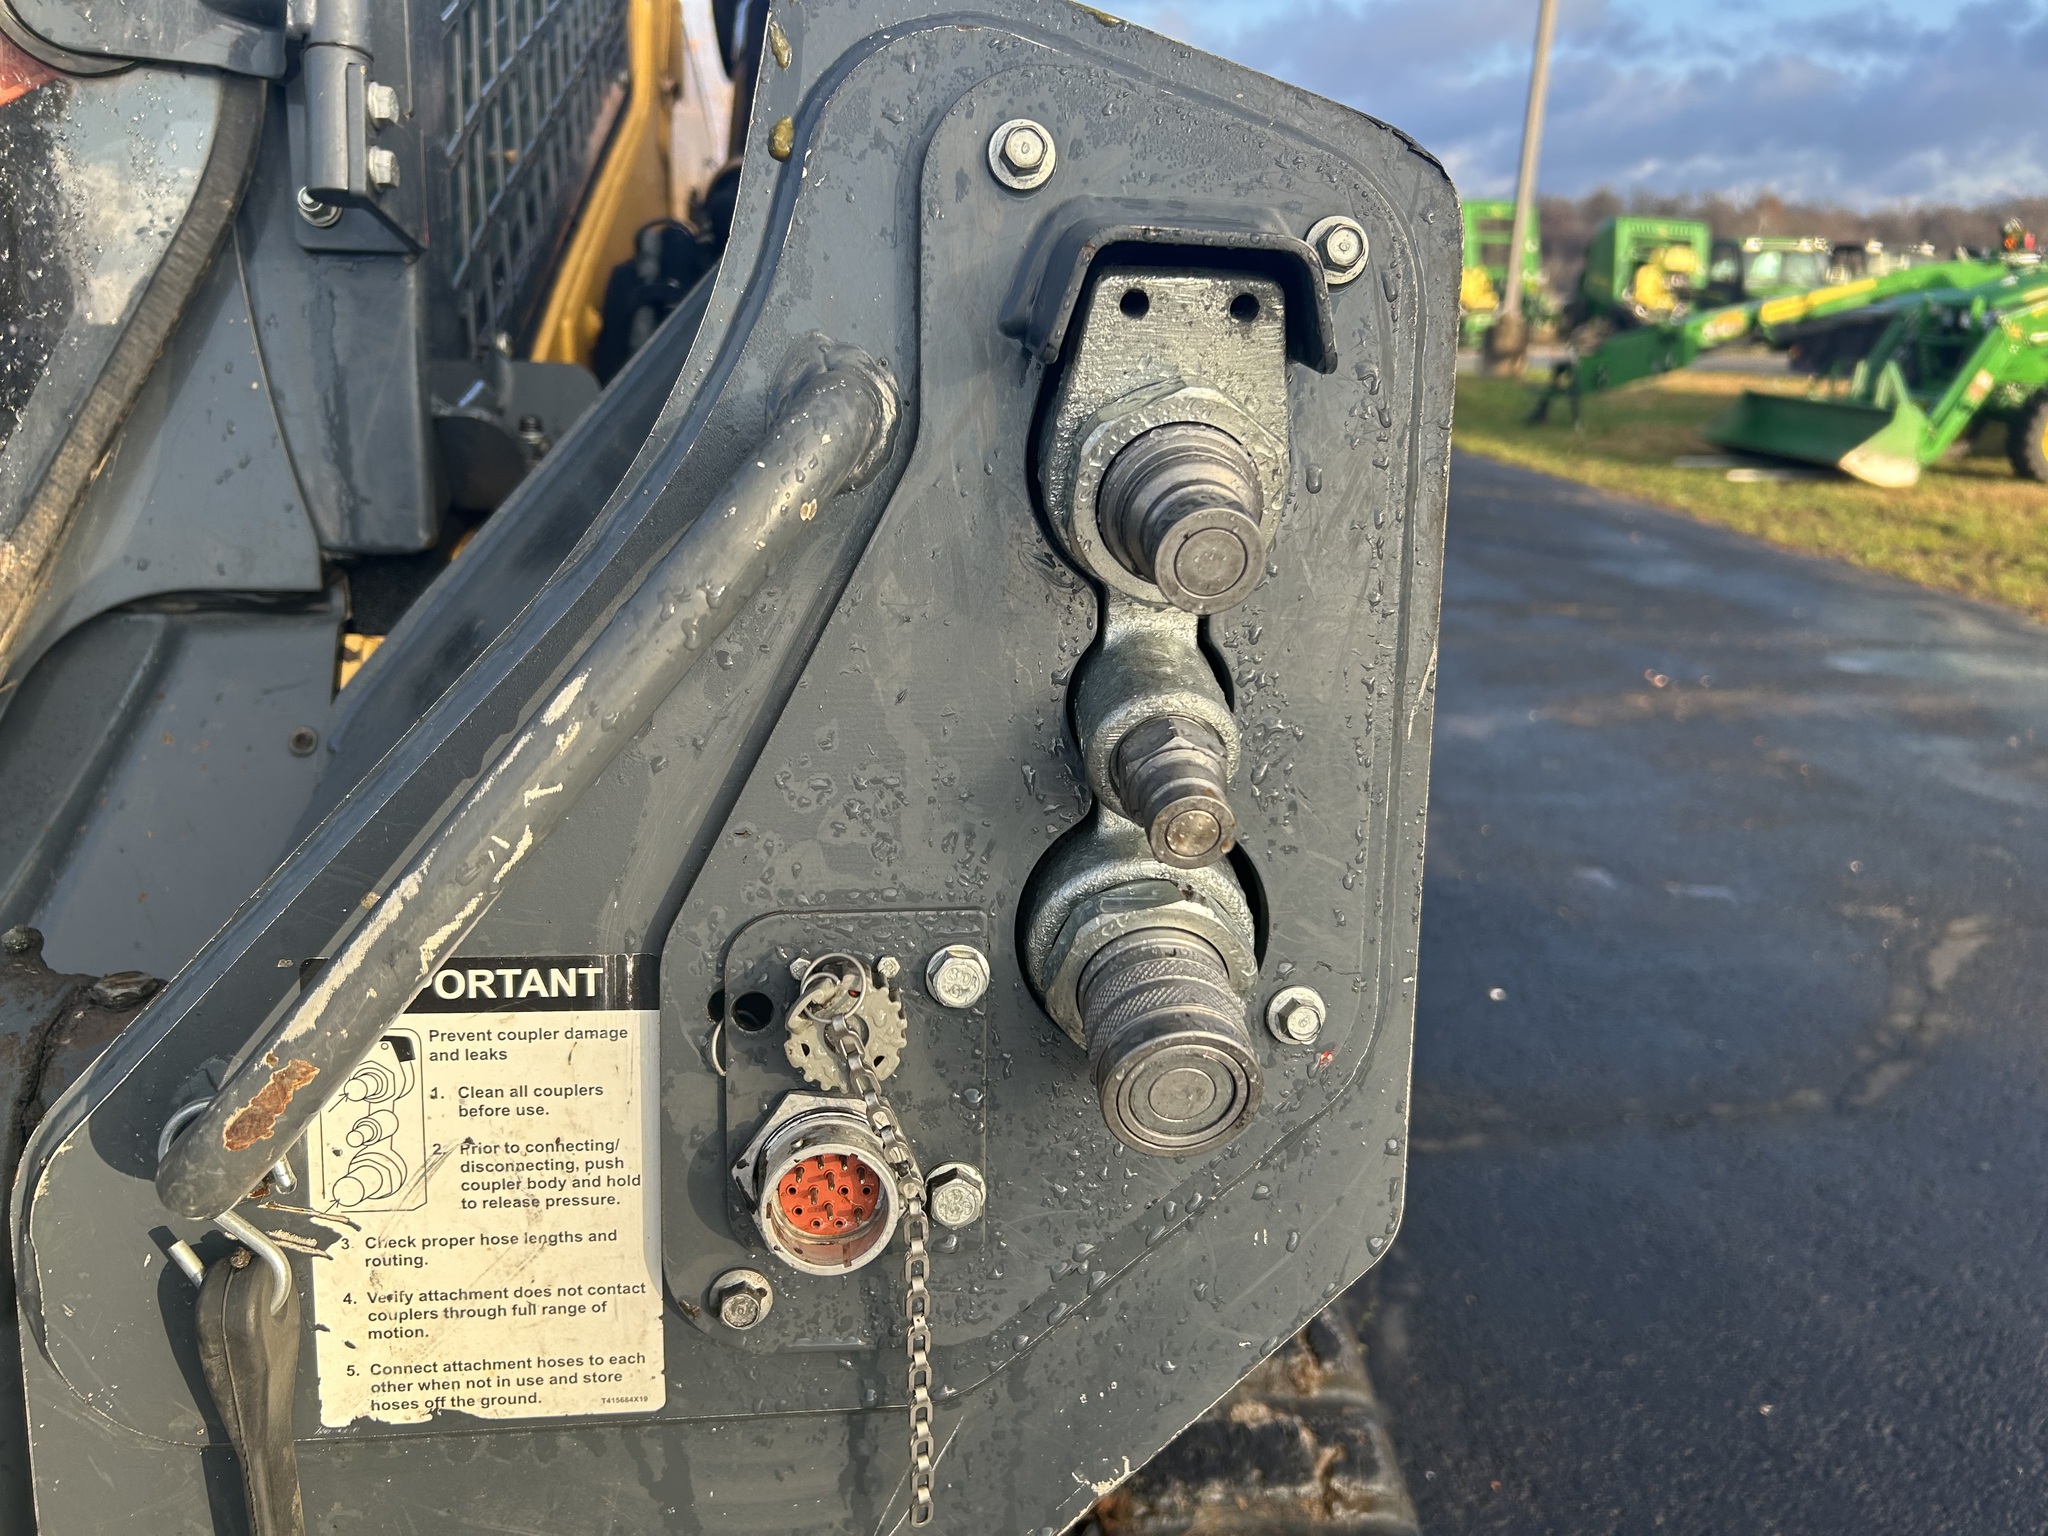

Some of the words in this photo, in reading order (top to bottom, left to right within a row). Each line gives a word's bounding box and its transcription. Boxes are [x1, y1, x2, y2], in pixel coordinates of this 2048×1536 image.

[424, 967, 604, 1000] ORTANT
[429, 1029, 493, 1042] Prevent
[497, 1027, 560, 1044] coupler
[564, 1026, 628, 1042] damage
[429, 1048, 460, 1062] and
[465, 1047, 508, 1061] leaks
[429, 1086, 445, 1100] 1.
[457, 1086, 504, 1099] Clean
[509, 1084, 528, 1098] all
[533, 1083, 604, 1100] couplers
[458, 1104, 511, 1118] before
[516, 1105, 550, 1116] use.
[459, 1142, 501, 1156] Prior
[503, 1141, 520, 1155] to
[524, 1138, 621, 1154] connecting/
[460, 1158, 580, 1174] disconnecting,
[585, 1156, 624, 1173] push
[460, 1176, 522, 1194] coupler
[527, 1176, 567, 1192] body
[571, 1175, 601, 1189] and
[606, 1173, 641, 1188] hold
[460, 1197, 477, 1210] to
[482, 1193, 541, 1209] release
[545, 1195, 620, 1210] pressure.
[365, 1235, 417, 1250] Check
[421, 1236, 476, 1251] proper
[480, 1233, 519, 1246] hose
[524, 1231, 583, 1248] lengths
[588, 1229, 617, 1242] and
[365, 1253, 429, 1269] routing.
[342, 1292, 357, 1305] 4.
[418, 1287, 509, 1302] attachment
[513, 1286, 552, 1299] does
[557, 1284, 583, 1297] not
[587, 1282, 646, 1296] contact
[367, 1307, 439, 1324] couplers
[442, 1304, 507, 1321] through
[511, 1301, 537, 1316] full
[542, 1304, 587, 1317] range
[591, 1300, 608, 1313] of
[368, 1326, 429, 1340] motion.
[346, 1364, 360, 1377] 5.
[370, 1361, 439, 1376] Connect
[442, 1357, 533, 1373] attachment
[537, 1356, 584, 1369] hoses
[588, 1354, 605, 1366] to
[608, 1352, 646, 1365] each
[370, 1380, 414, 1394] other
[417, 1378, 461, 1391] when
[466, 1376, 492, 1389] not
[496, 1375, 511, 1388] in
[516, 1376, 544, 1387] use
[549, 1372, 578, 1386] and
[582, 1371, 623, 1384] store
[370, 1399, 420, 1412] hoses
[424, 1396, 447, 1409] off
[450, 1395, 476, 1409] the
[480, 1391, 542, 1409] ground.
